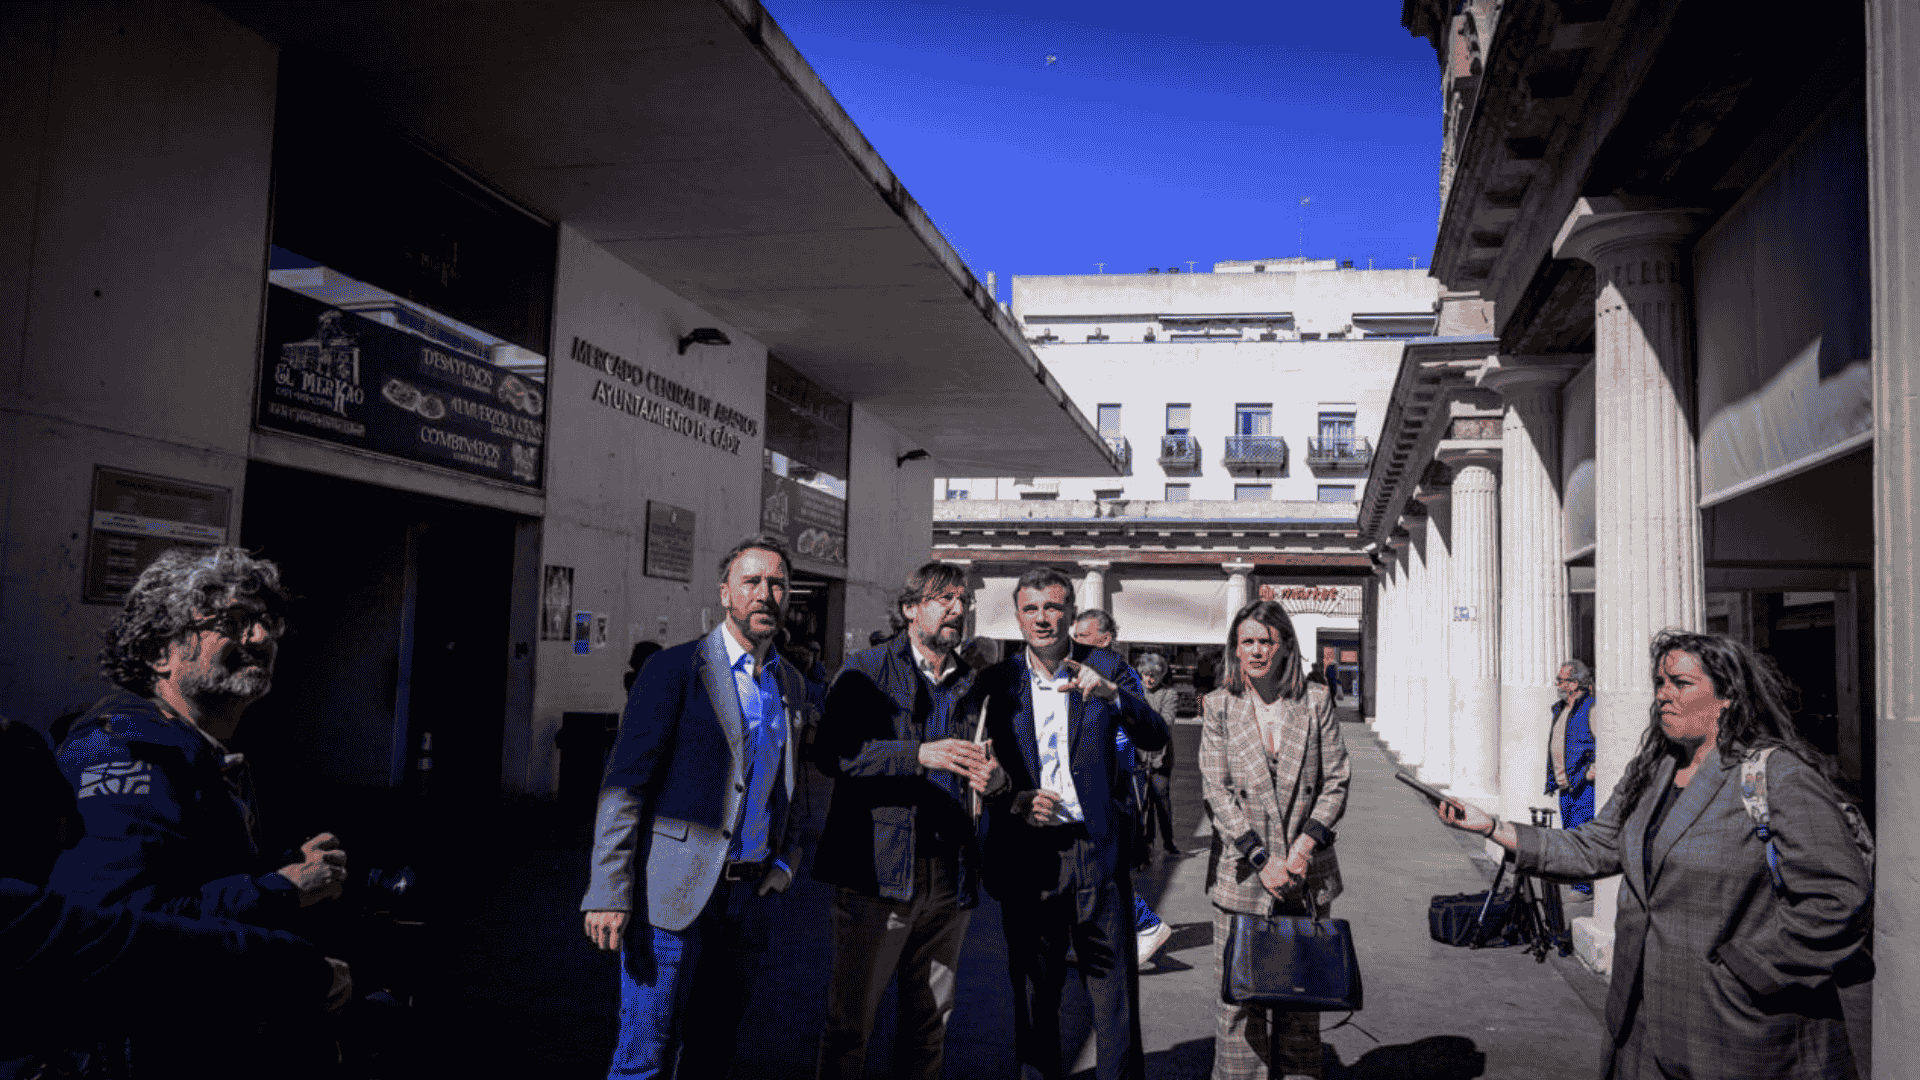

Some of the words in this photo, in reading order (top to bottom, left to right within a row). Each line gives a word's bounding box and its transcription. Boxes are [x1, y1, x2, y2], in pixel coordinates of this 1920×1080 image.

[423, 347, 494, 385] DESAYUNOS
[571, 336, 643, 387] MERCADO
[645, 368, 695, 412] CENTRAL
[592, 379, 692, 437] AYUNTAMIENTO
[420, 426, 501, 461] COMBINADOS
